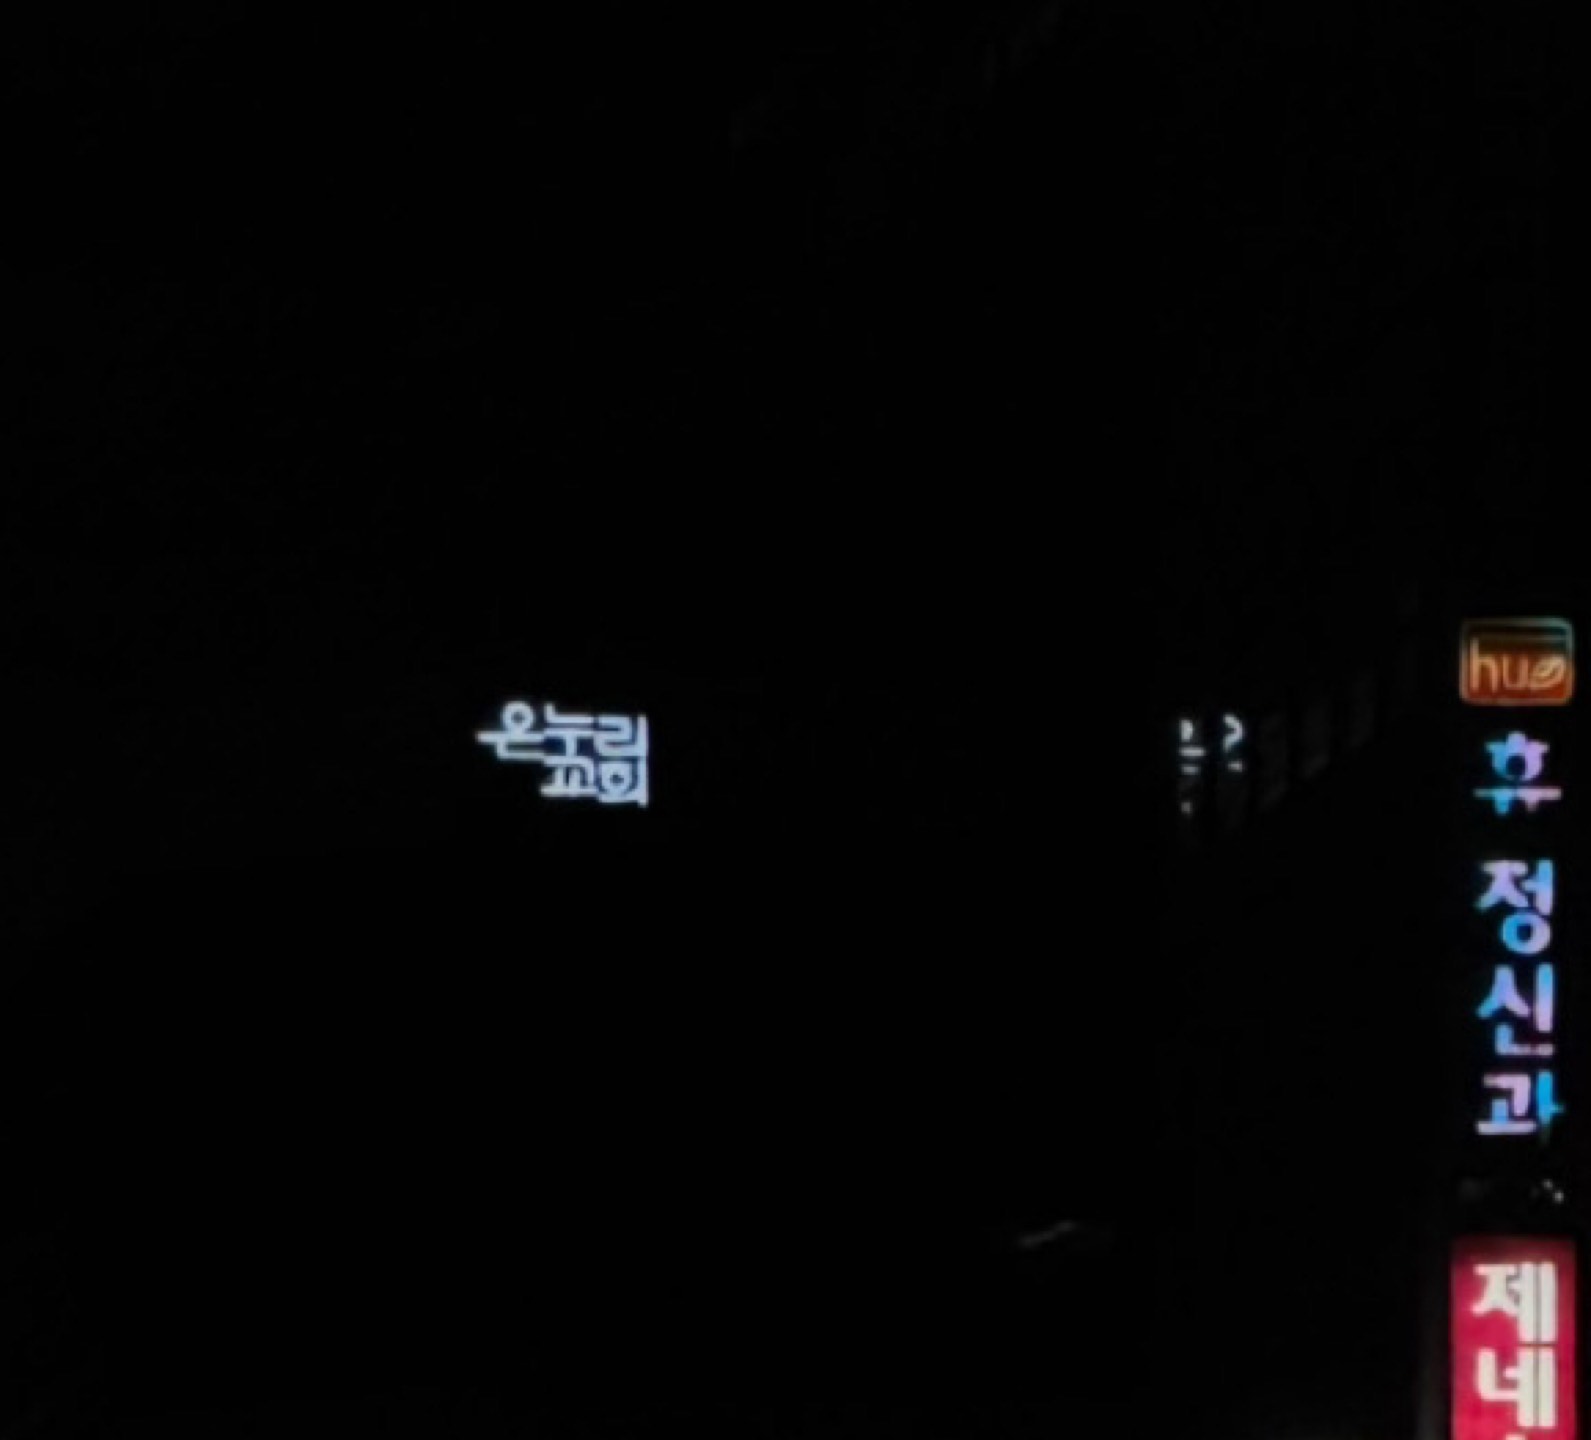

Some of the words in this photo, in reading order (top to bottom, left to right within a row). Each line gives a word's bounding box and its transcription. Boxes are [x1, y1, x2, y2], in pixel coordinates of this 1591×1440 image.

[475, 700, 649, 760] 온누리
[539, 754, 649, 808] 교회
[1474, 730, 1563, 816] 휴
[1474, 858, 1564, 1137] 정신과
